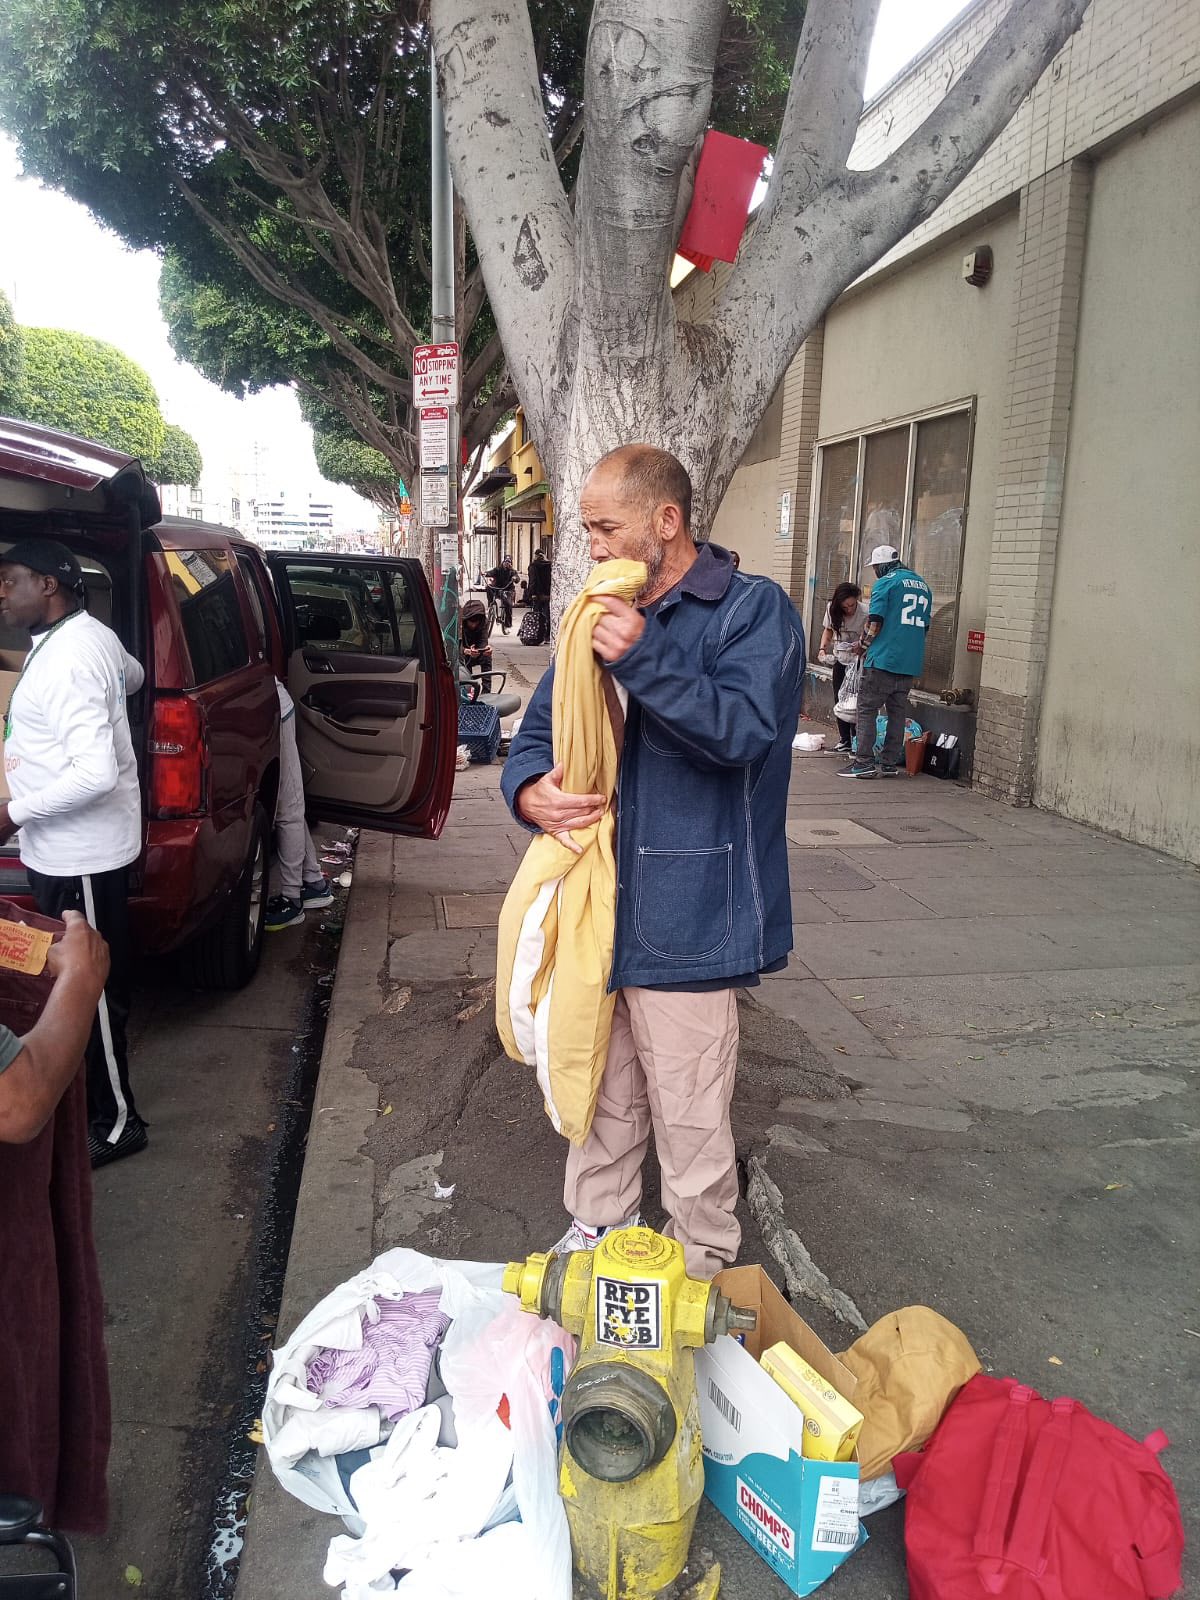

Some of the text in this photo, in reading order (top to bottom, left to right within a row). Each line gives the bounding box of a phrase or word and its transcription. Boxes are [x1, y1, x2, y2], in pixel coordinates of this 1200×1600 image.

[415, 359, 456, 373] NO STOPPING
[419, 375, 452, 386] ANY TIME
[901, 593, 928, 627] 22
[605, 1282, 650, 1304] RED
[605, 1303, 649, 1324] EYE
[740, 1486, 790, 1549] CHOMPS
[757, 1527, 778, 1556] BEEF
